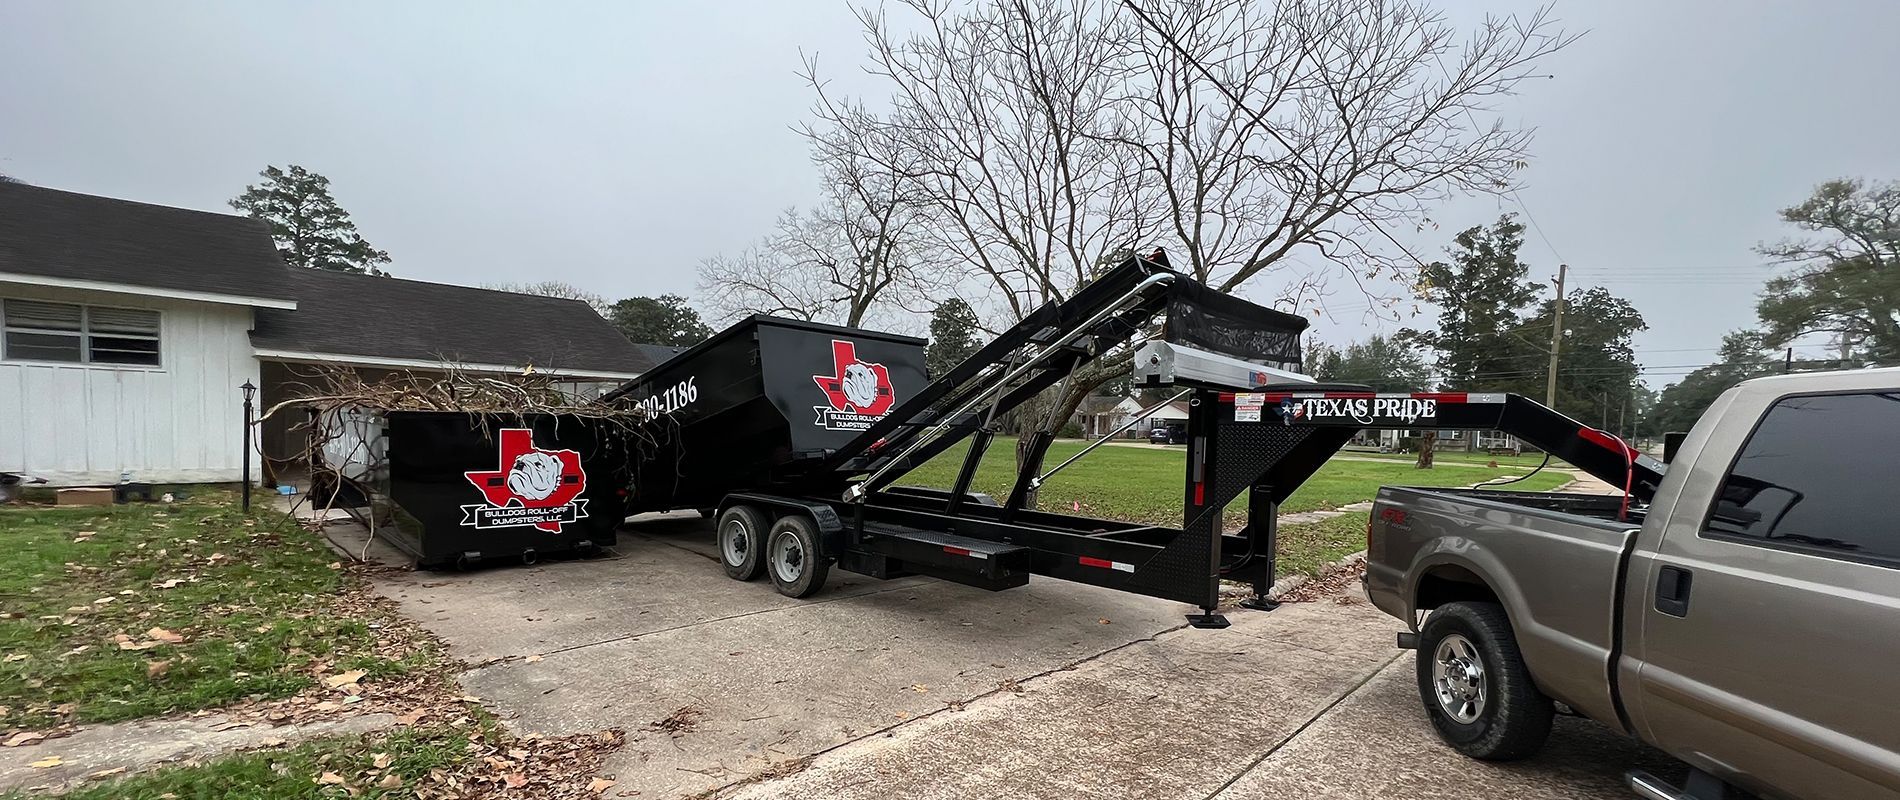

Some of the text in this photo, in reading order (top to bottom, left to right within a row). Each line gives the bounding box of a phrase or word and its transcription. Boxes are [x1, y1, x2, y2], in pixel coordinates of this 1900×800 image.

[639, 375, 698, 423] 00-1186
[830, 413, 885, 422] BULLDOG ROLL-OF
[1303, 398, 1437, 425] TEXAS PRIDE
[485, 506, 569, 518] BULLDOG ROLL-OFF
